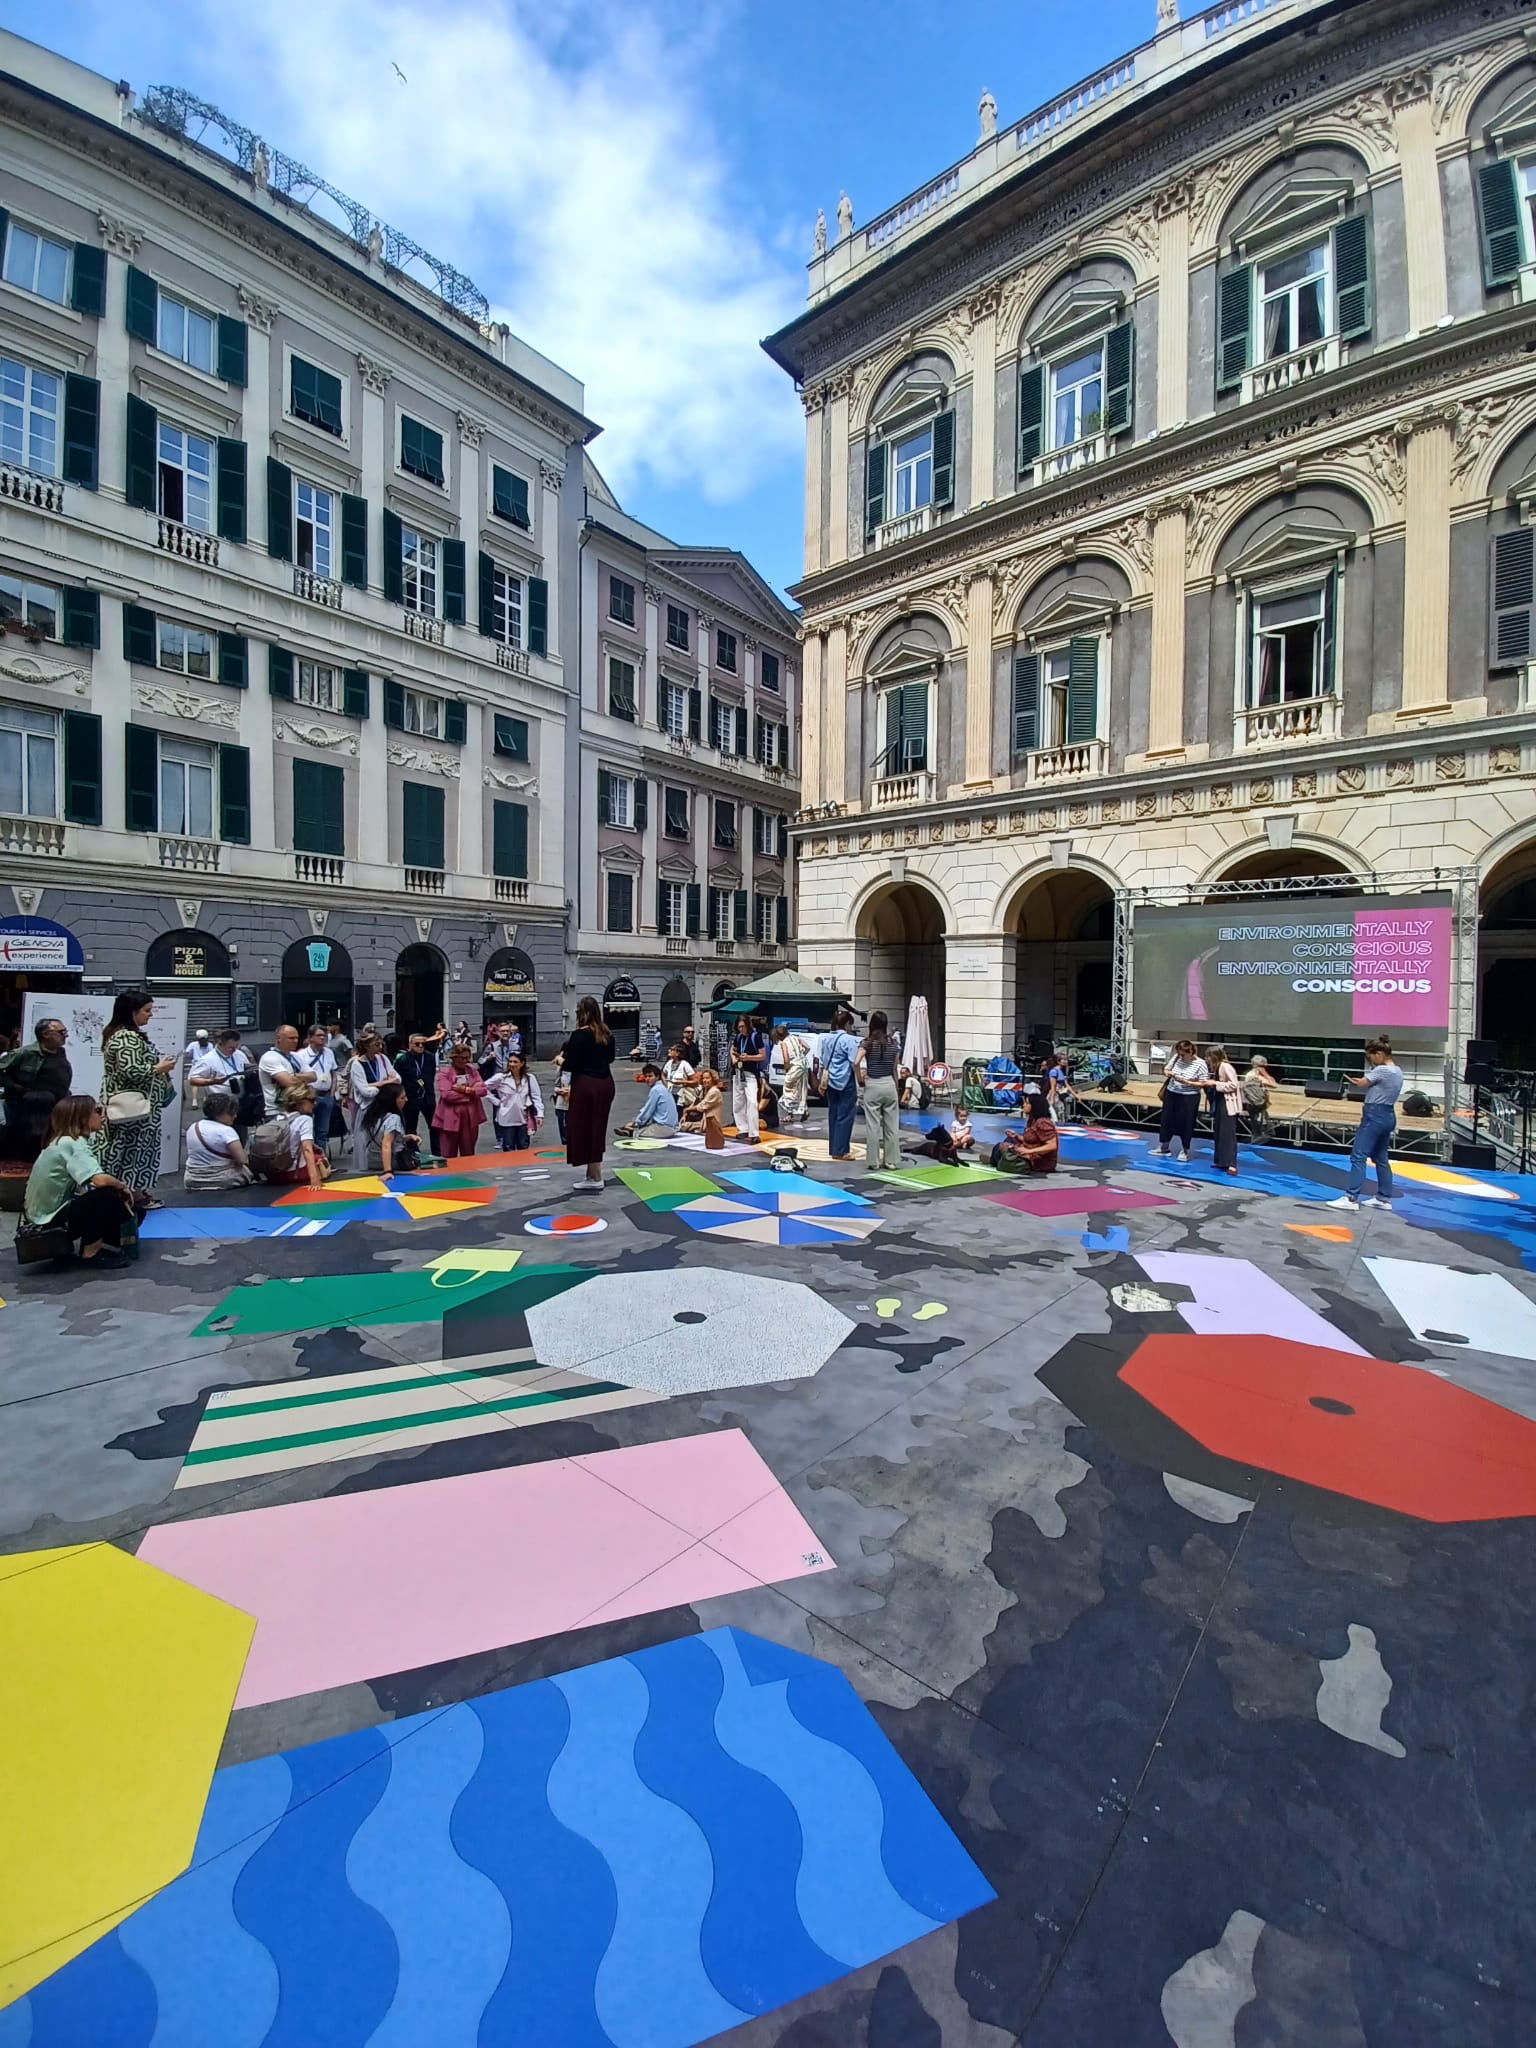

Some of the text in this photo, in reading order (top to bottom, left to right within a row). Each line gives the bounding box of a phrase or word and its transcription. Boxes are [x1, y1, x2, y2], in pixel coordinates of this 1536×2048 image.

[1218, 920, 1433, 941] ENVIRONMENTALLY
[11, 938, 64, 948] GENOVA
[174, 946, 204, 955] PIZZA
[1292, 941, 1433, 957] CONSCIOUS
[11, 951, 64, 960] experience
[184, 954, 195, 965] &
[174, 968, 204, 976] HOUSE
[1217, 959, 1432, 976] ENVIRONMENTALLY
[1291, 978, 1433, 994] CONSCIOUS
